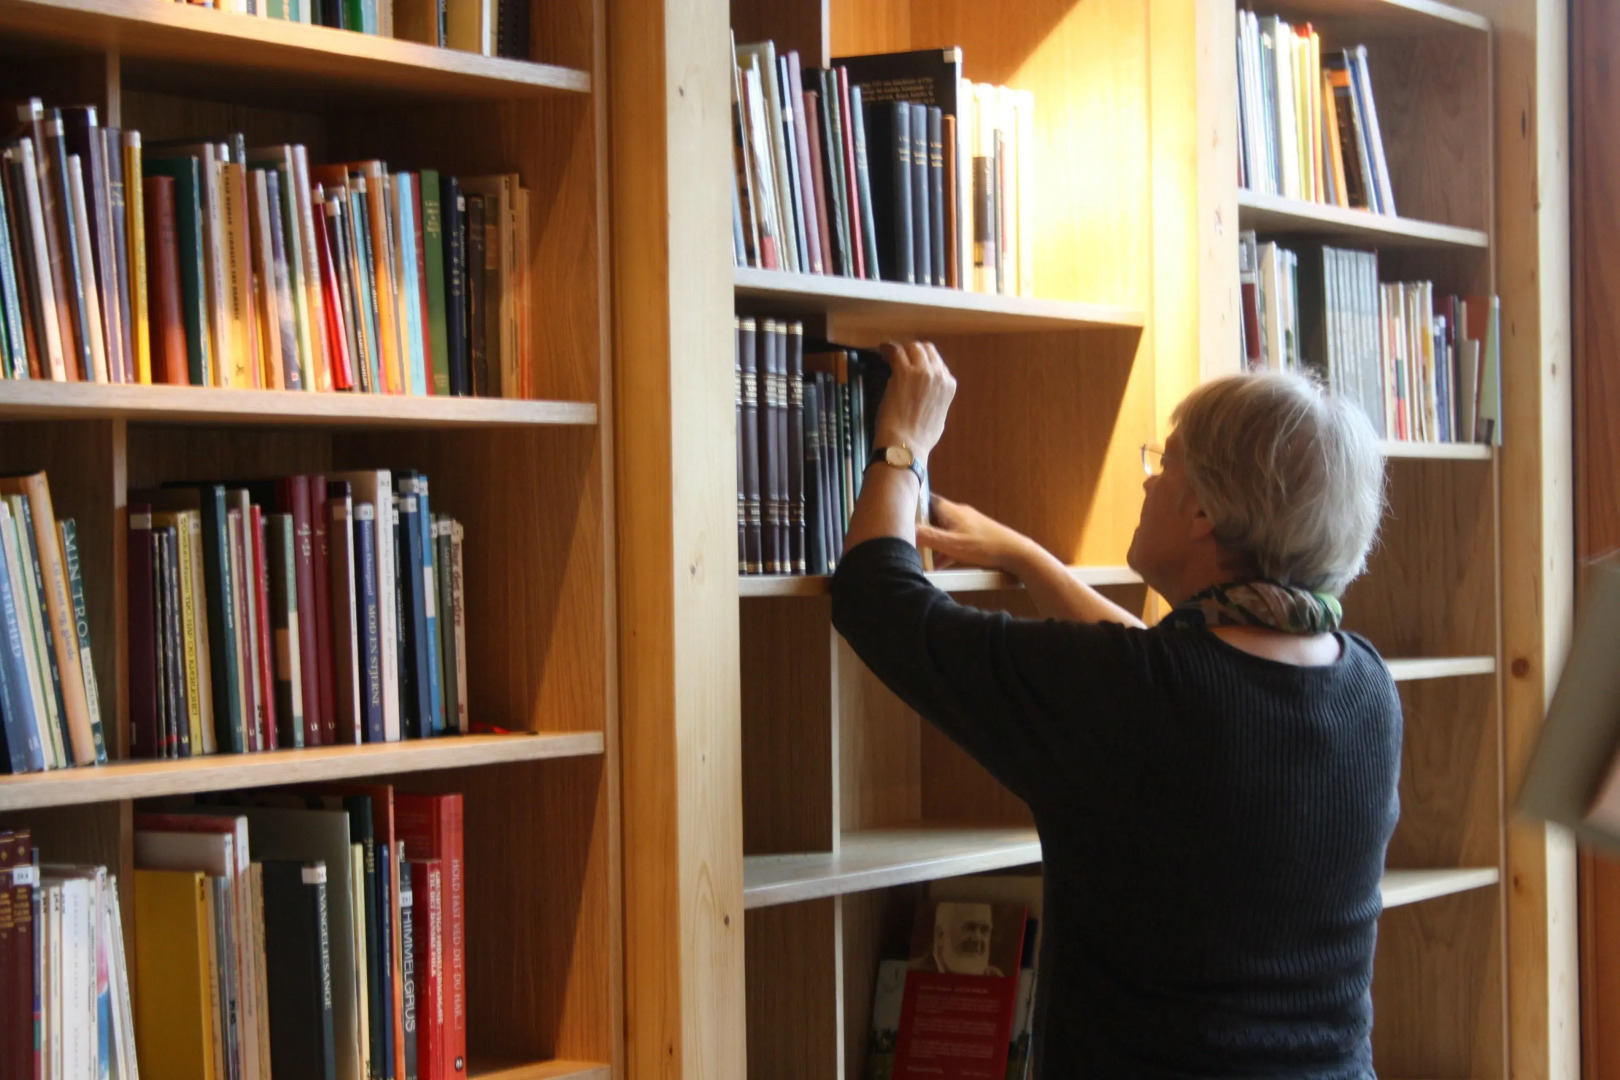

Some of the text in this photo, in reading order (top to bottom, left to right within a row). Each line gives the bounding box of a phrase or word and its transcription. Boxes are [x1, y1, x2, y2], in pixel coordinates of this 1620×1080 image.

[65, 533, 88, 638] MIN TRO
[453, 571, 462, 592] det
[367, 605, 377, 634] MOD
[369, 637, 378, 654] EN
[369, 656, 380, 707] STJERNE
[452, 860, 461, 890] HOLD
[453, 896, 461, 921] FAST
[319, 885, 332, 1010] EVANGELIESANGE
[453, 923, 462, 945] VED
[402, 910, 415, 1033] HIMMELGRUS
[453, 949, 462, 969] DET
[453, 974, 462, 990] DU
